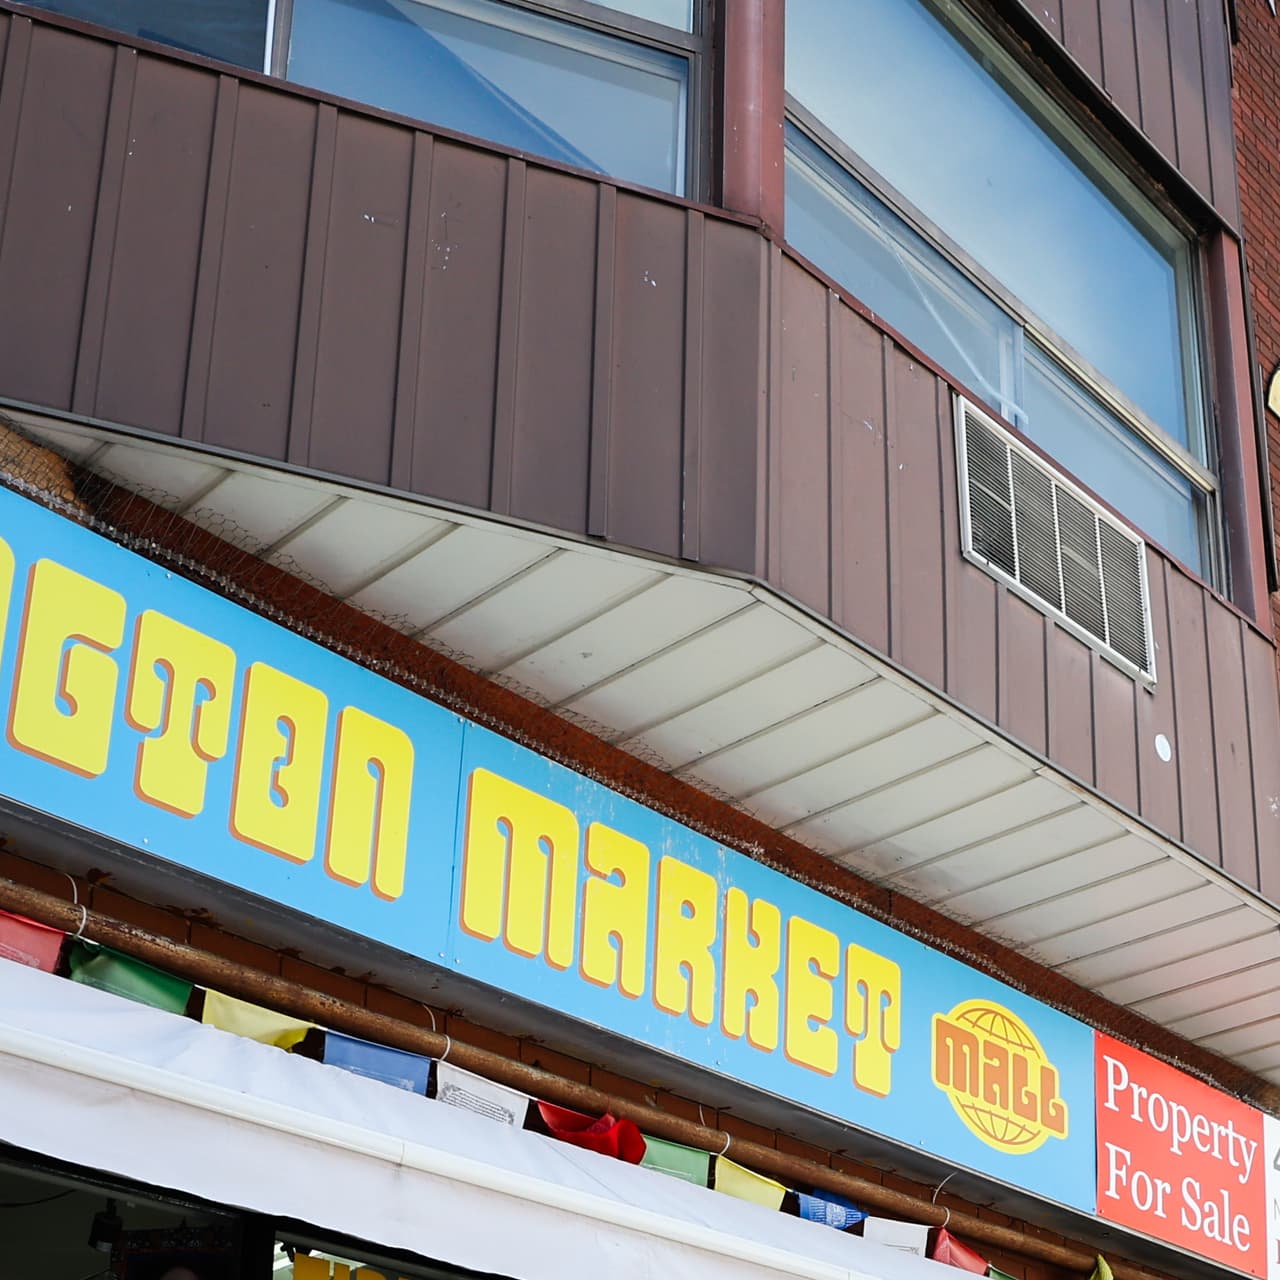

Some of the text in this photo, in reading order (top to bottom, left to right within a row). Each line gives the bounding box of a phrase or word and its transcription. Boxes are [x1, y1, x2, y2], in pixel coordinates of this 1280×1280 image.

[459, 767, 901, 1097] MARKET
[1103, 1055, 1258, 1184] Property
[1105, 1142, 1251, 1252] For Sale
